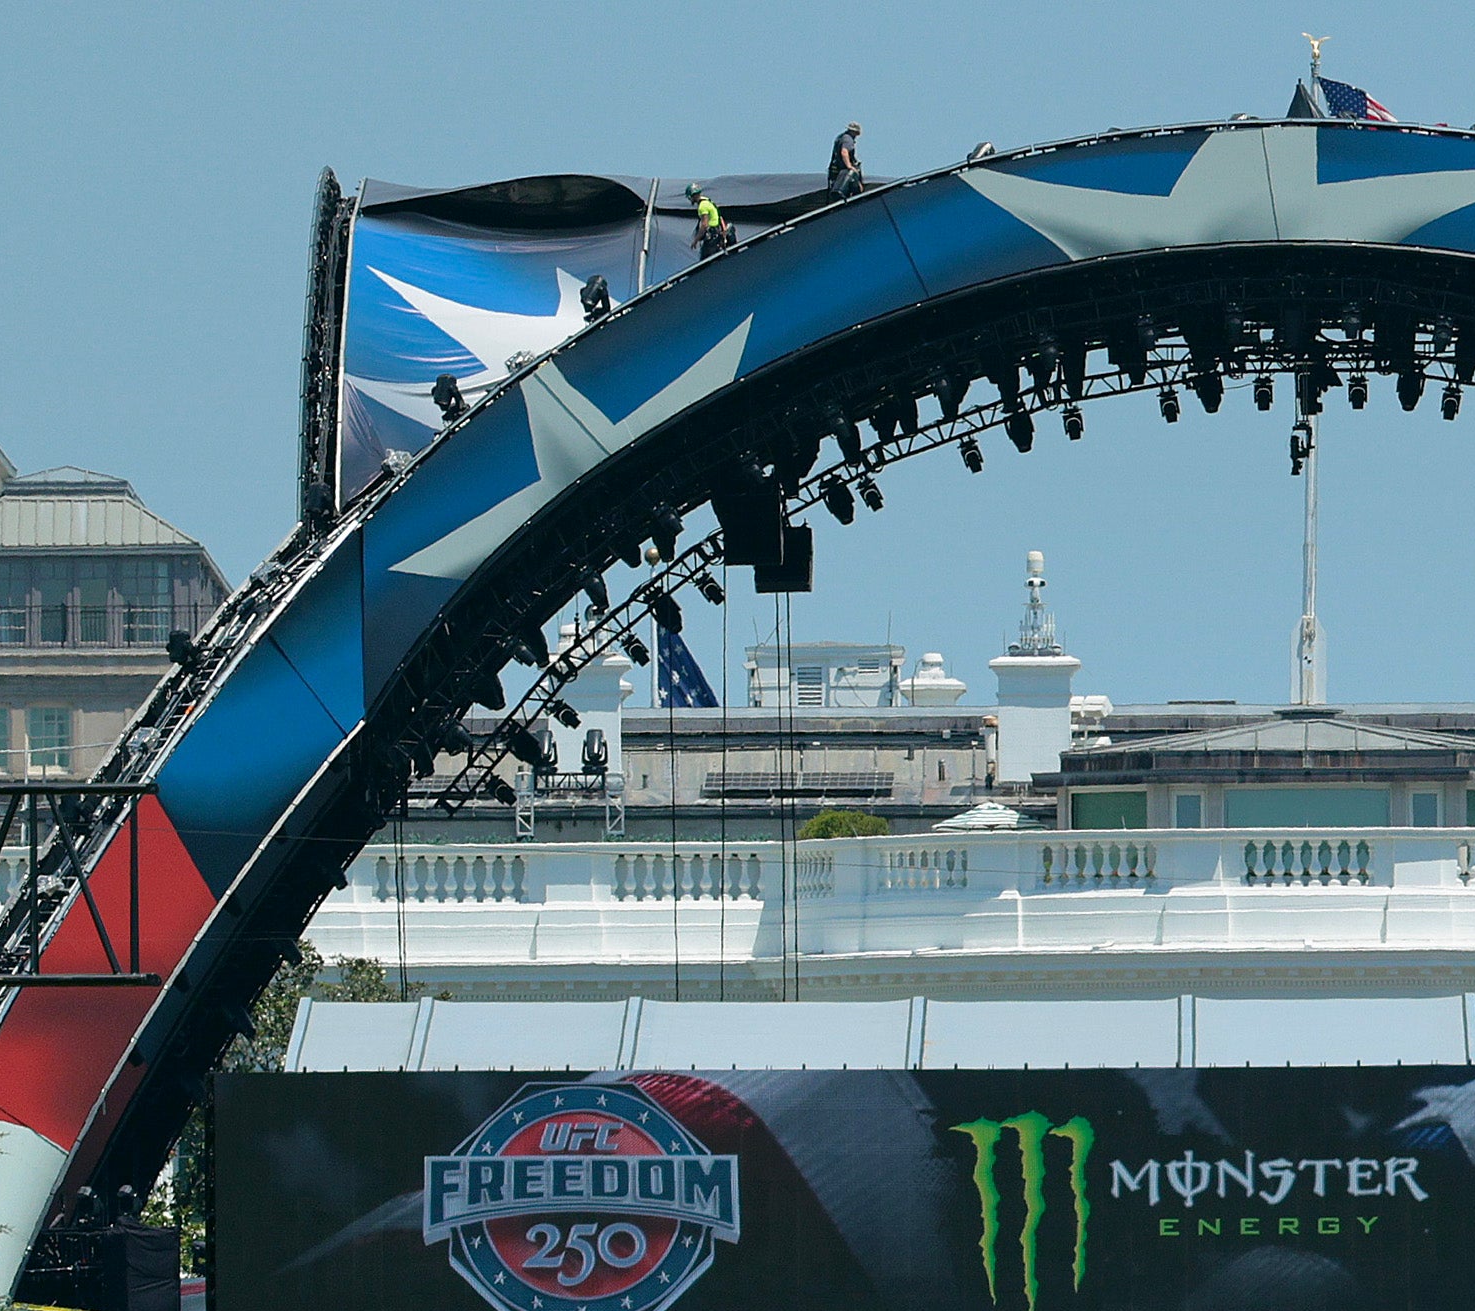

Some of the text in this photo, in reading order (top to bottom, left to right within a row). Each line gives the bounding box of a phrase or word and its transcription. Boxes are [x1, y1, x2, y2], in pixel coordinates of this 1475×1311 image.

[538, 1122, 624, 1151] UFC
[429, 1159, 735, 1226] FREEDOM
[1108, 1149, 1429, 1207] MONSTER
[521, 1221, 647, 1286] 250
[1158, 1216, 1379, 1237] ENERGY
